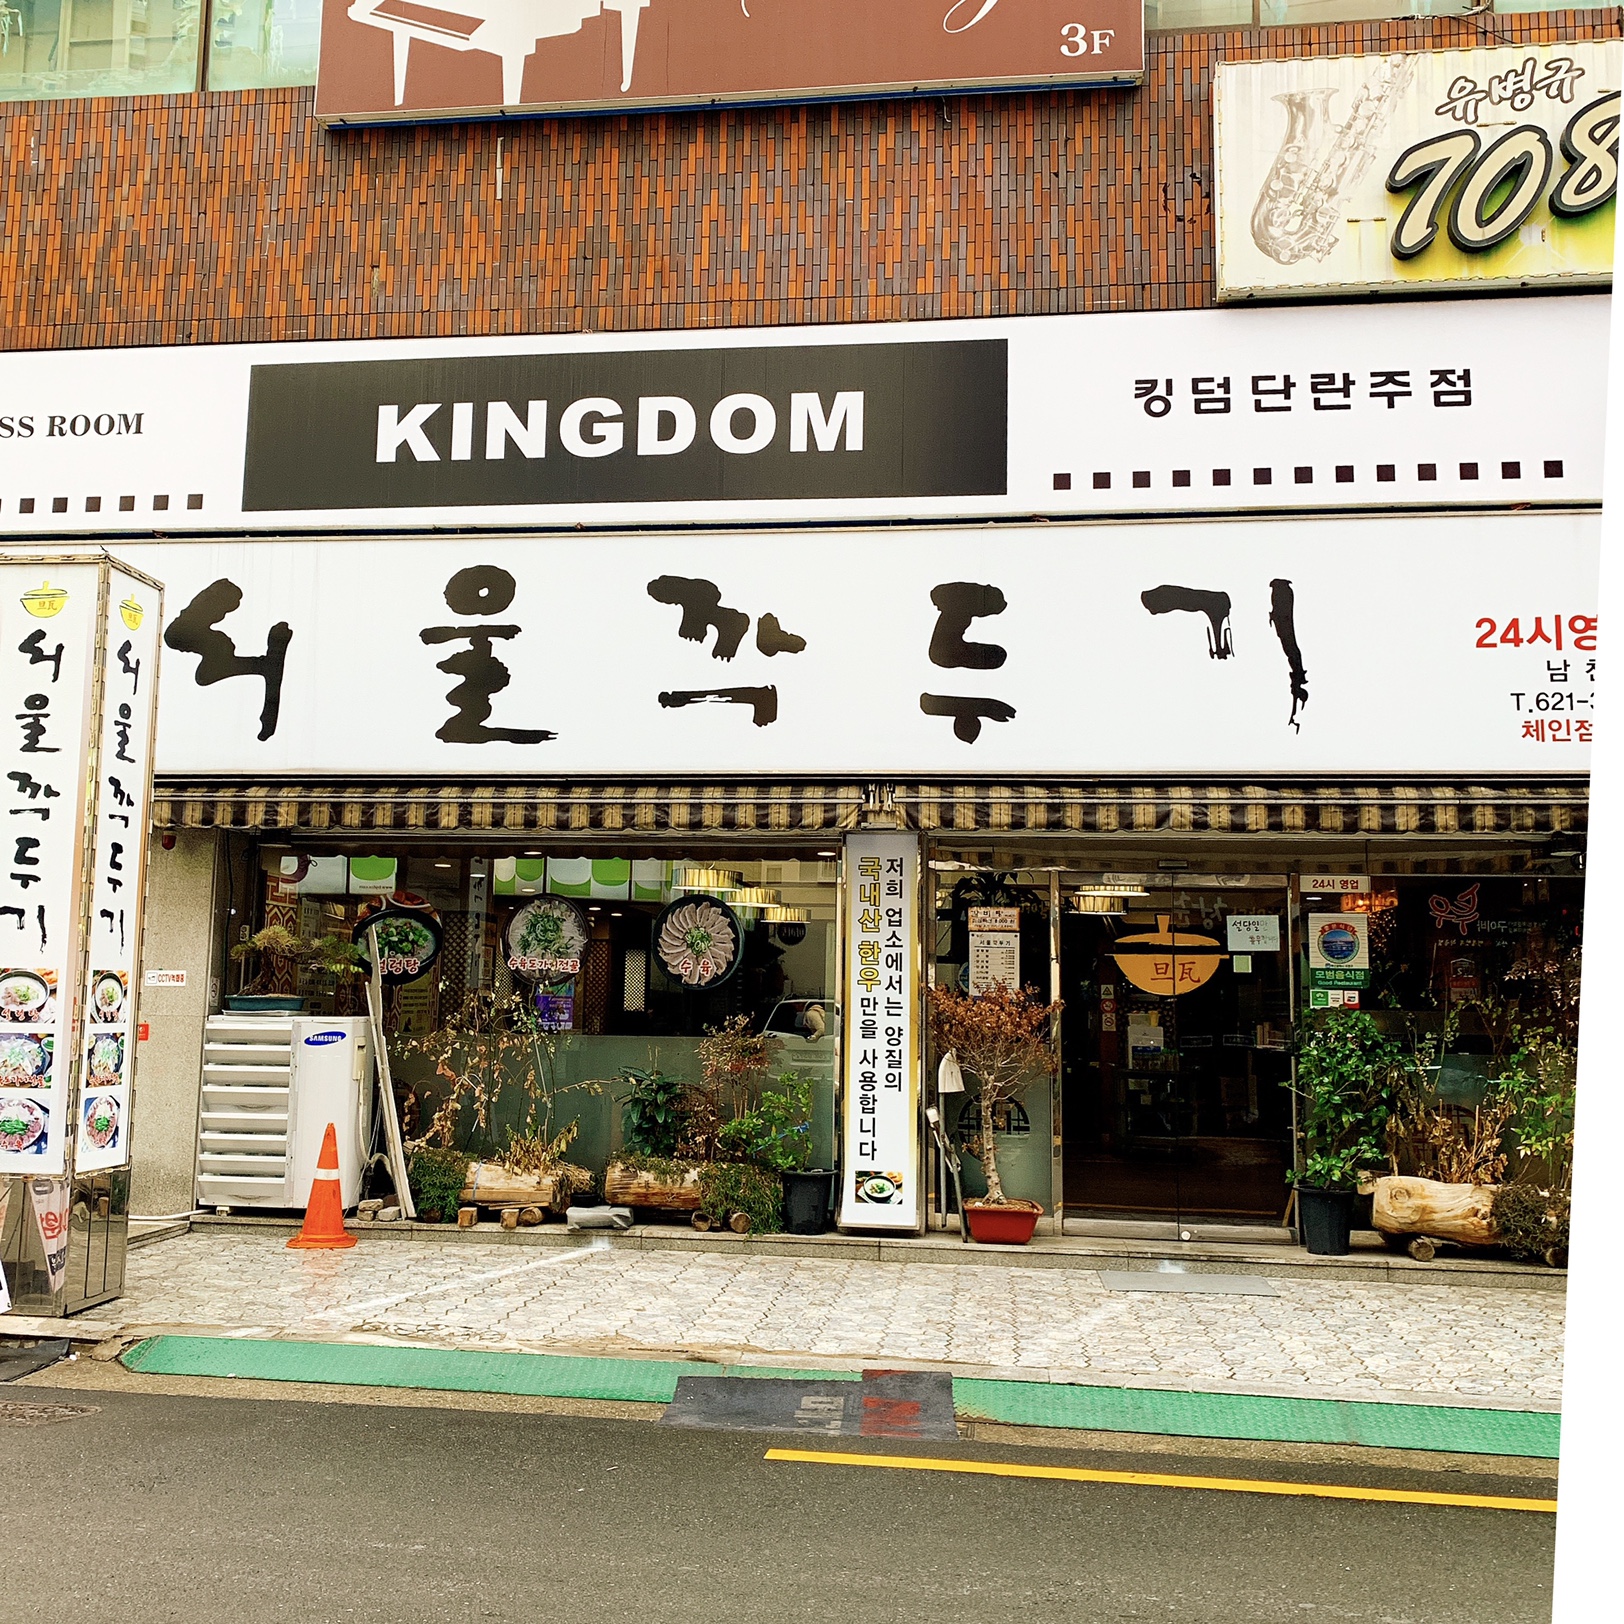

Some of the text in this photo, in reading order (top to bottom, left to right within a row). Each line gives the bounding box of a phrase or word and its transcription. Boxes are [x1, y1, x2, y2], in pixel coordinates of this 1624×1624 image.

[1060, 23, 1115, 57] 3F
[1434, 56, 1586, 124] 유병규
[46, 412, 145, 437] ROOM
[375, 390, 864, 463] KINGDOM
[1510, 692, 1595, 713] T.621-
[857, 856, 882, 934] 국내산
[1312, 879, 1360, 890] 24시 영업
[680, 959, 712, 976] 수육
[884, 857, 904, 1093] 저희 업소에서는 양질의
[1315, 970, 1365, 980] 모범음식점
[858, 1048, 878, 1161] 사용합니다
